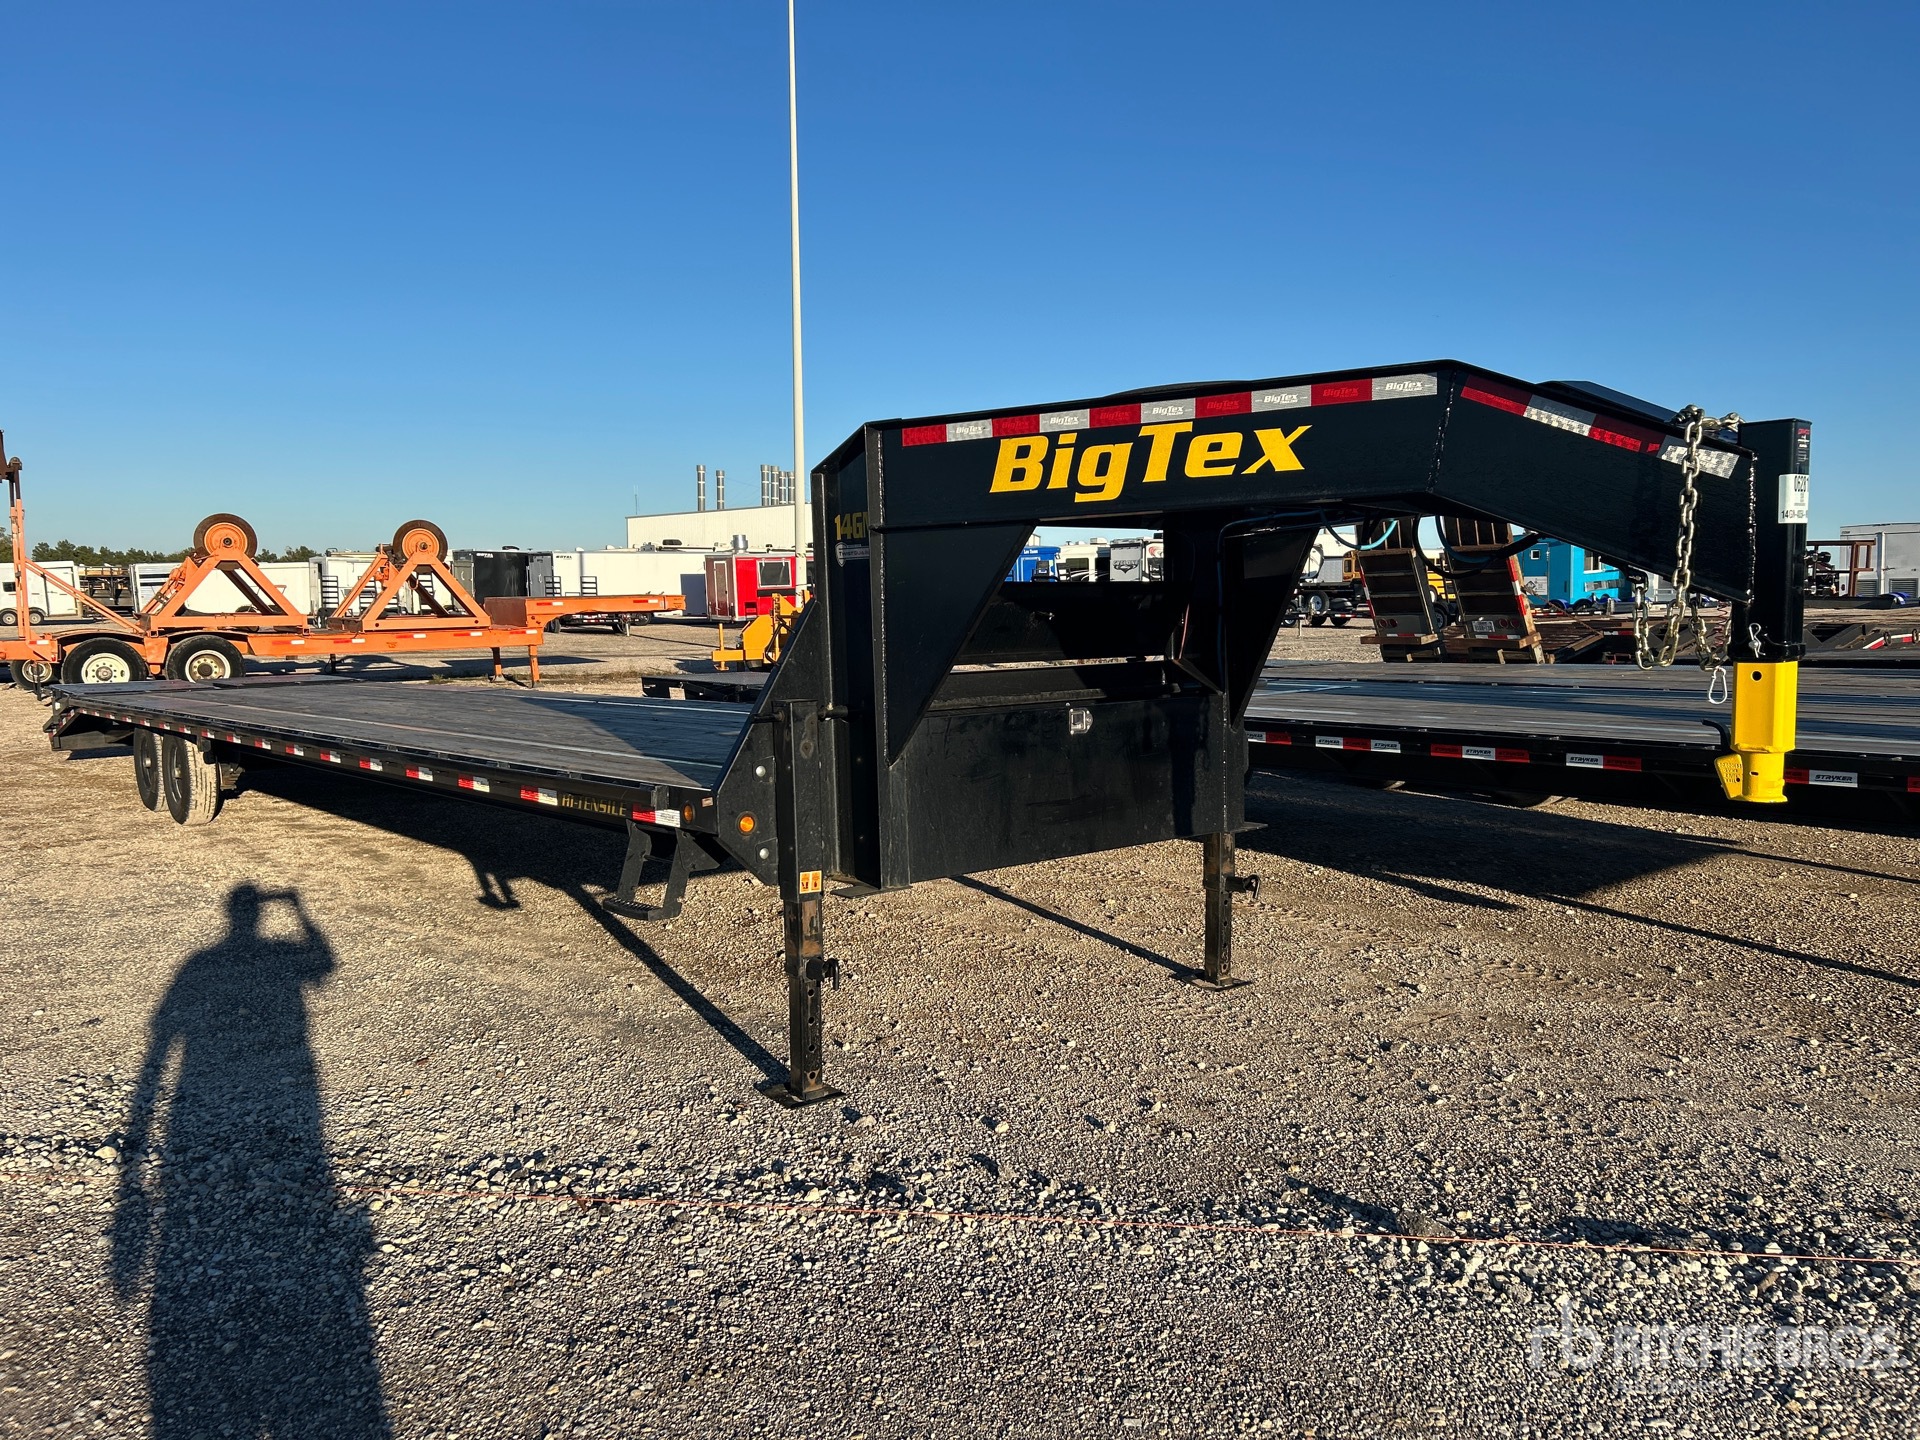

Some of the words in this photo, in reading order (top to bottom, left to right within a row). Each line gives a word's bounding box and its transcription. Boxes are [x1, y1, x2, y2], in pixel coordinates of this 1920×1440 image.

[1385, 381, 1423, 391] BigTex
[1263, 393, 1299, 404] BigTex
[1152, 405, 1184, 416] BigTex
[1050, 416, 1079, 425] BigTex
[955, 425, 983, 435] BigTex
[989, 421, 1313, 503] BigTex
[1814, 774, 1853, 783] STRYKER
[562, 794, 627, 816] HI-TENSILE
